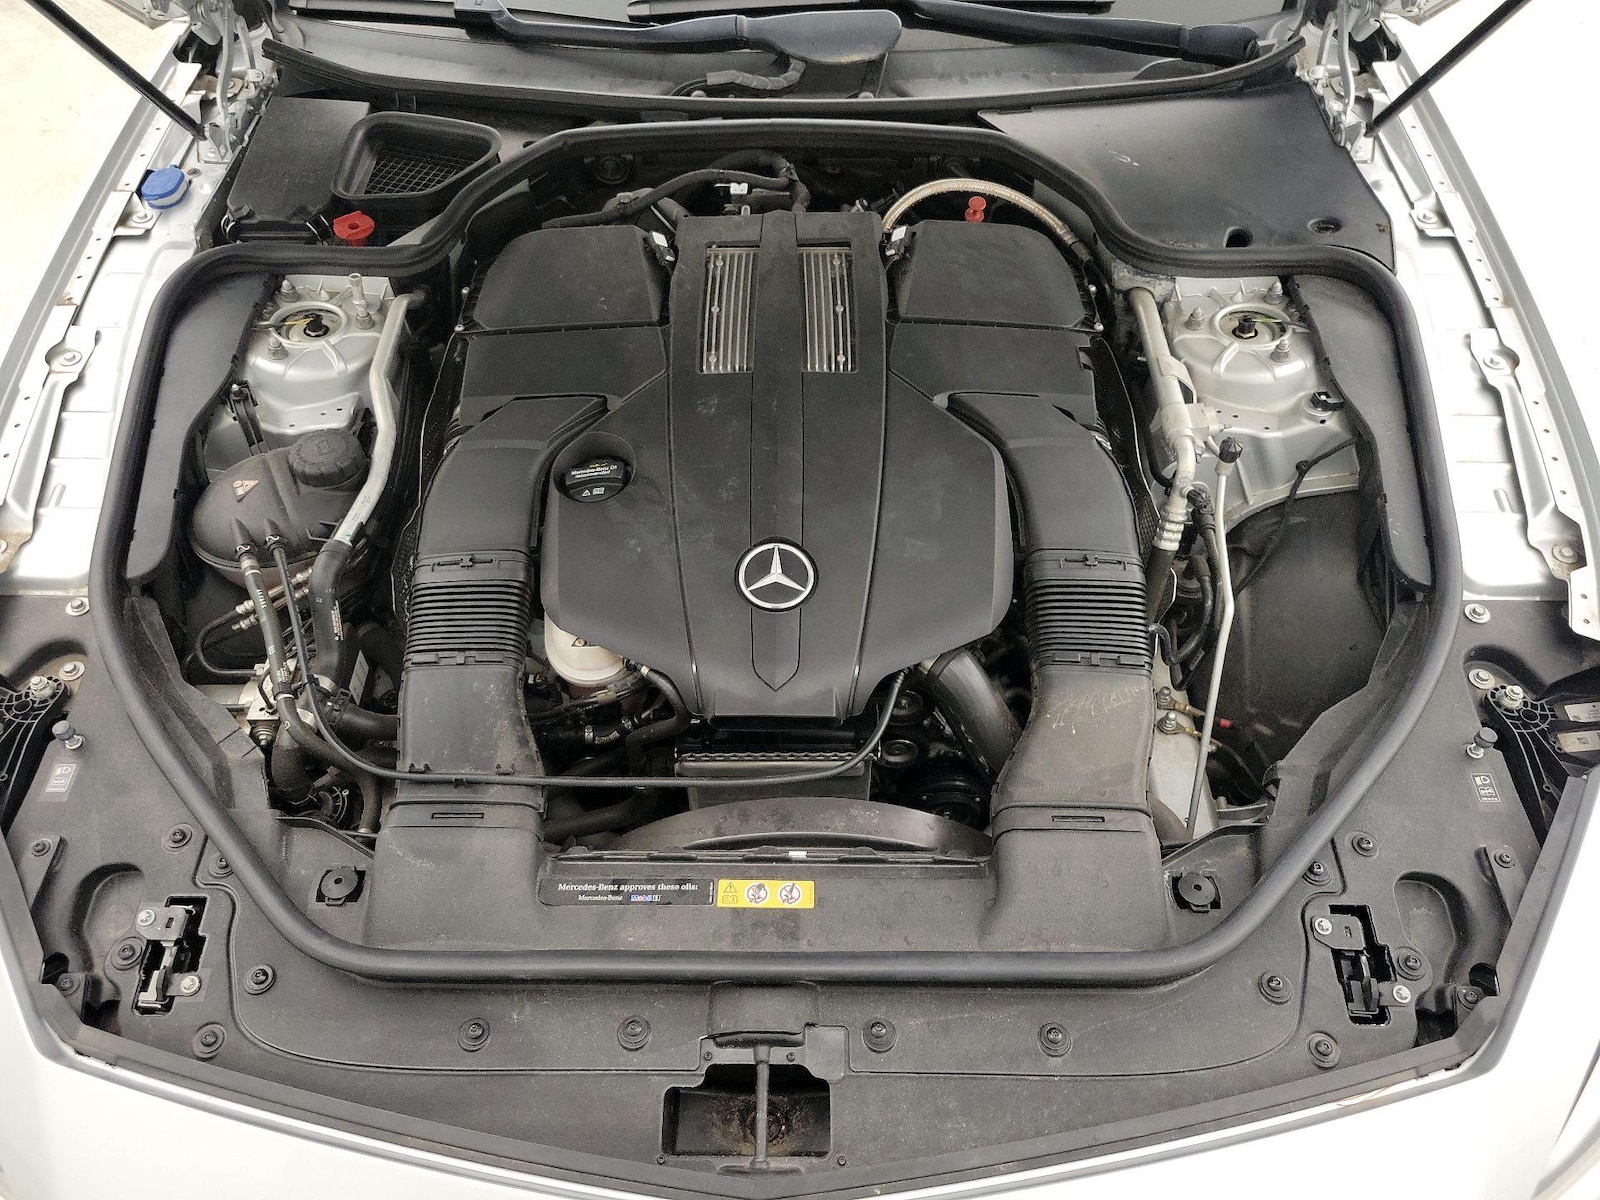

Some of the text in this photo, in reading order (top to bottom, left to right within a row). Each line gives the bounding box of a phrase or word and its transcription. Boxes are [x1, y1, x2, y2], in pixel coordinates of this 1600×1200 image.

[558, 883, 699, 892] Mercedes-Benz approves these oils:
